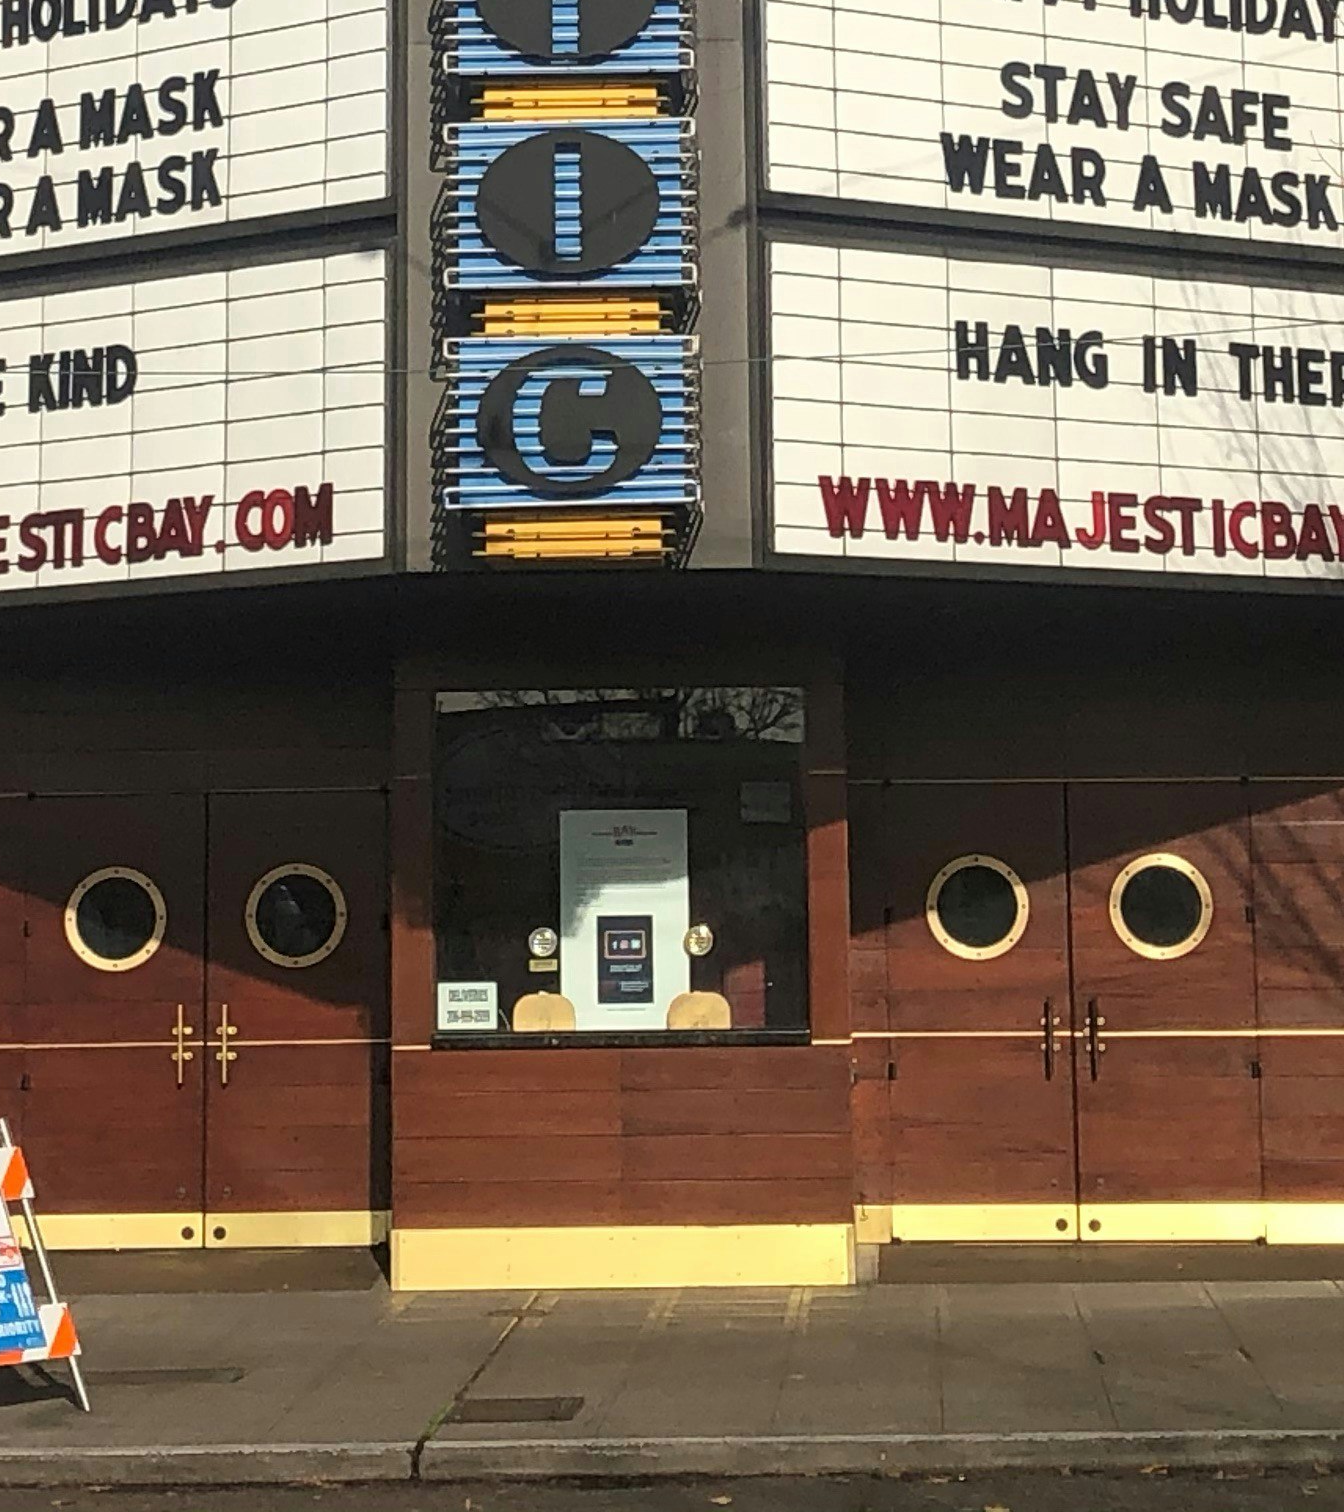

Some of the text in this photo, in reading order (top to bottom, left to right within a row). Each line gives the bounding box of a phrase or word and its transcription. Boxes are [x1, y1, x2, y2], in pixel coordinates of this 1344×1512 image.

[28, 99, 64, 159] A
[80, 70, 223, 150] MASK
[1002, 62, 1293, 151] STAY SAFE
[26, 176, 62, 236] A
[78, 149, 222, 228] MASK
[941, 133, 1339, 232] WEAR A MASK
[29, 345, 138, 415] KIND
[956, 321, 1109, 389] HANG
[1144, 336, 1198, 398] IN
